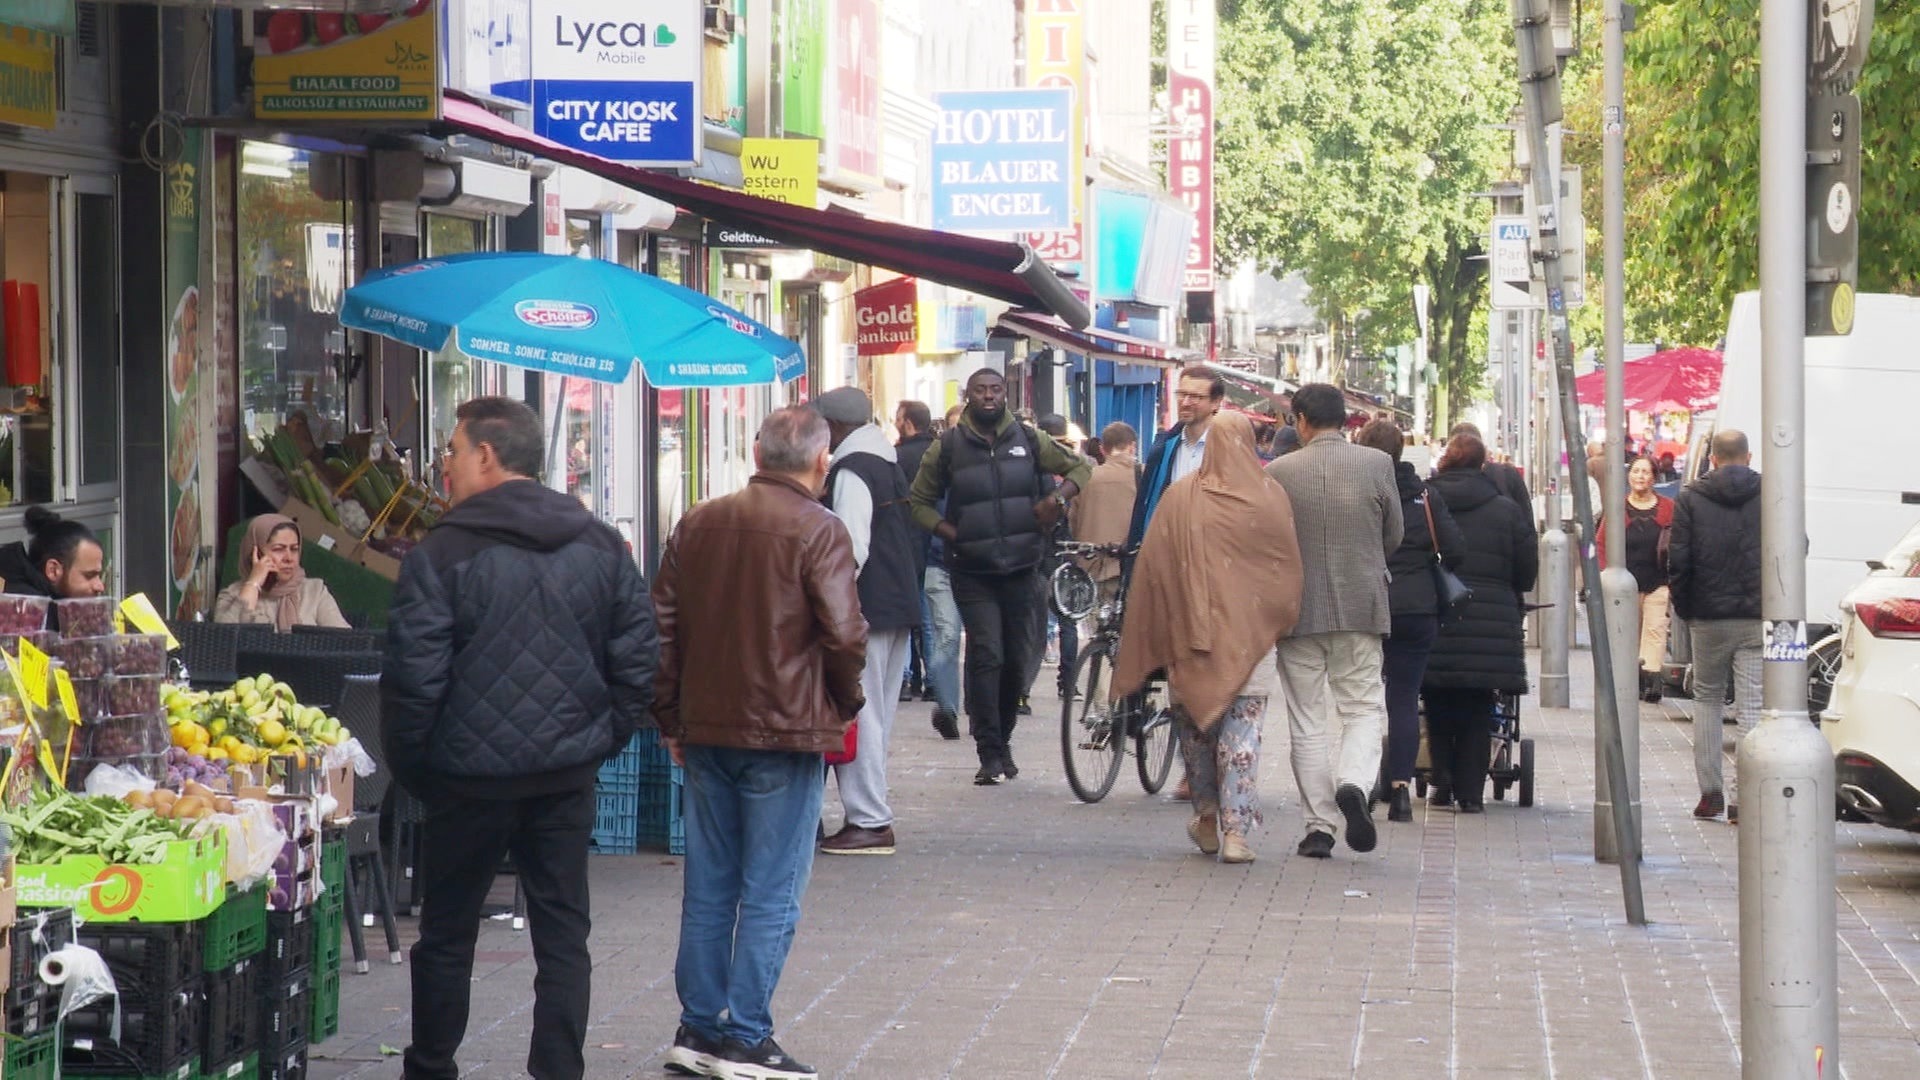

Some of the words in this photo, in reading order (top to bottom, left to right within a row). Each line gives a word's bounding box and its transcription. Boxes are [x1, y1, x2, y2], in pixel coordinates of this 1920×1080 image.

[556, 15, 646, 53] Lyca
[597, 51, 646, 65] Mobile
[296, 78, 345, 90] HALAL
[351, 78, 396, 90] FOOD
[265, 96, 334, 109] ALKOLSÜZ
[337, 97, 425, 109] RESTAURANT
[548, 101, 600, 121] CITY
[605, 101, 678, 121] KIOSK
[579, 122, 652, 142] CAFEE
[935, 108, 1066, 144] HOTEL
[750, 155, 779, 170] WU
[941, 160, 1060, 184] BLAUER
[743, 175, 799, 189] estern
[951, 193, 1051, 217] ENGEL
[858, 326, 917, 344] ankauf
[598, 359, 615, 372] EIS
[711, 363, 748, 375] MOMENTS
